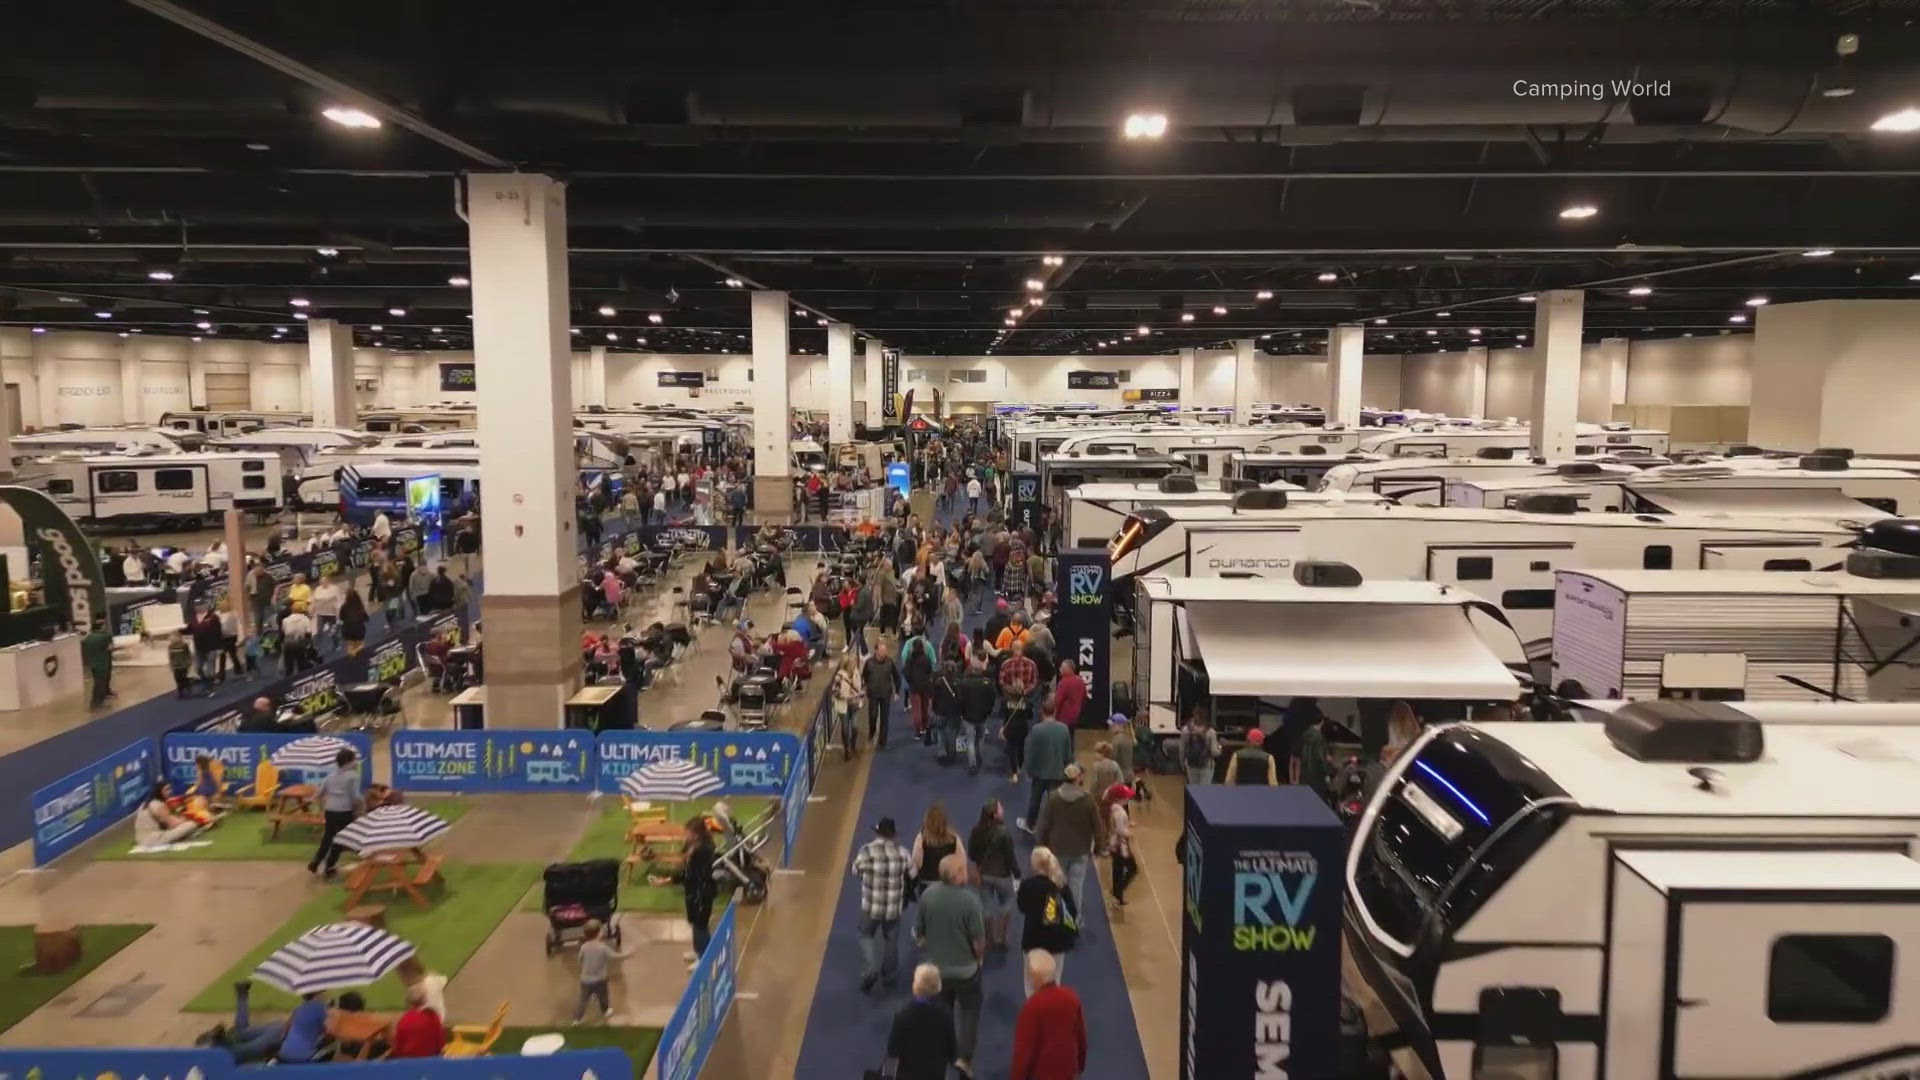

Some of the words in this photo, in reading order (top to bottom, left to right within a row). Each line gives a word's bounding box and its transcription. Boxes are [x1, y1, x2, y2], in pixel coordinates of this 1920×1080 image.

[1071, 573, 1103, 595] RV
[1071, 595, 1103, 604] SHOW
[1079, 638, 1094, 666] KZ
[394, 742, 477, 758] ULTIMATE
[600, 743, 681, 761] ULTIMATE
[1234, 872, 1317, 927] RV
[1233, 924, 1317, 951] SHOW
